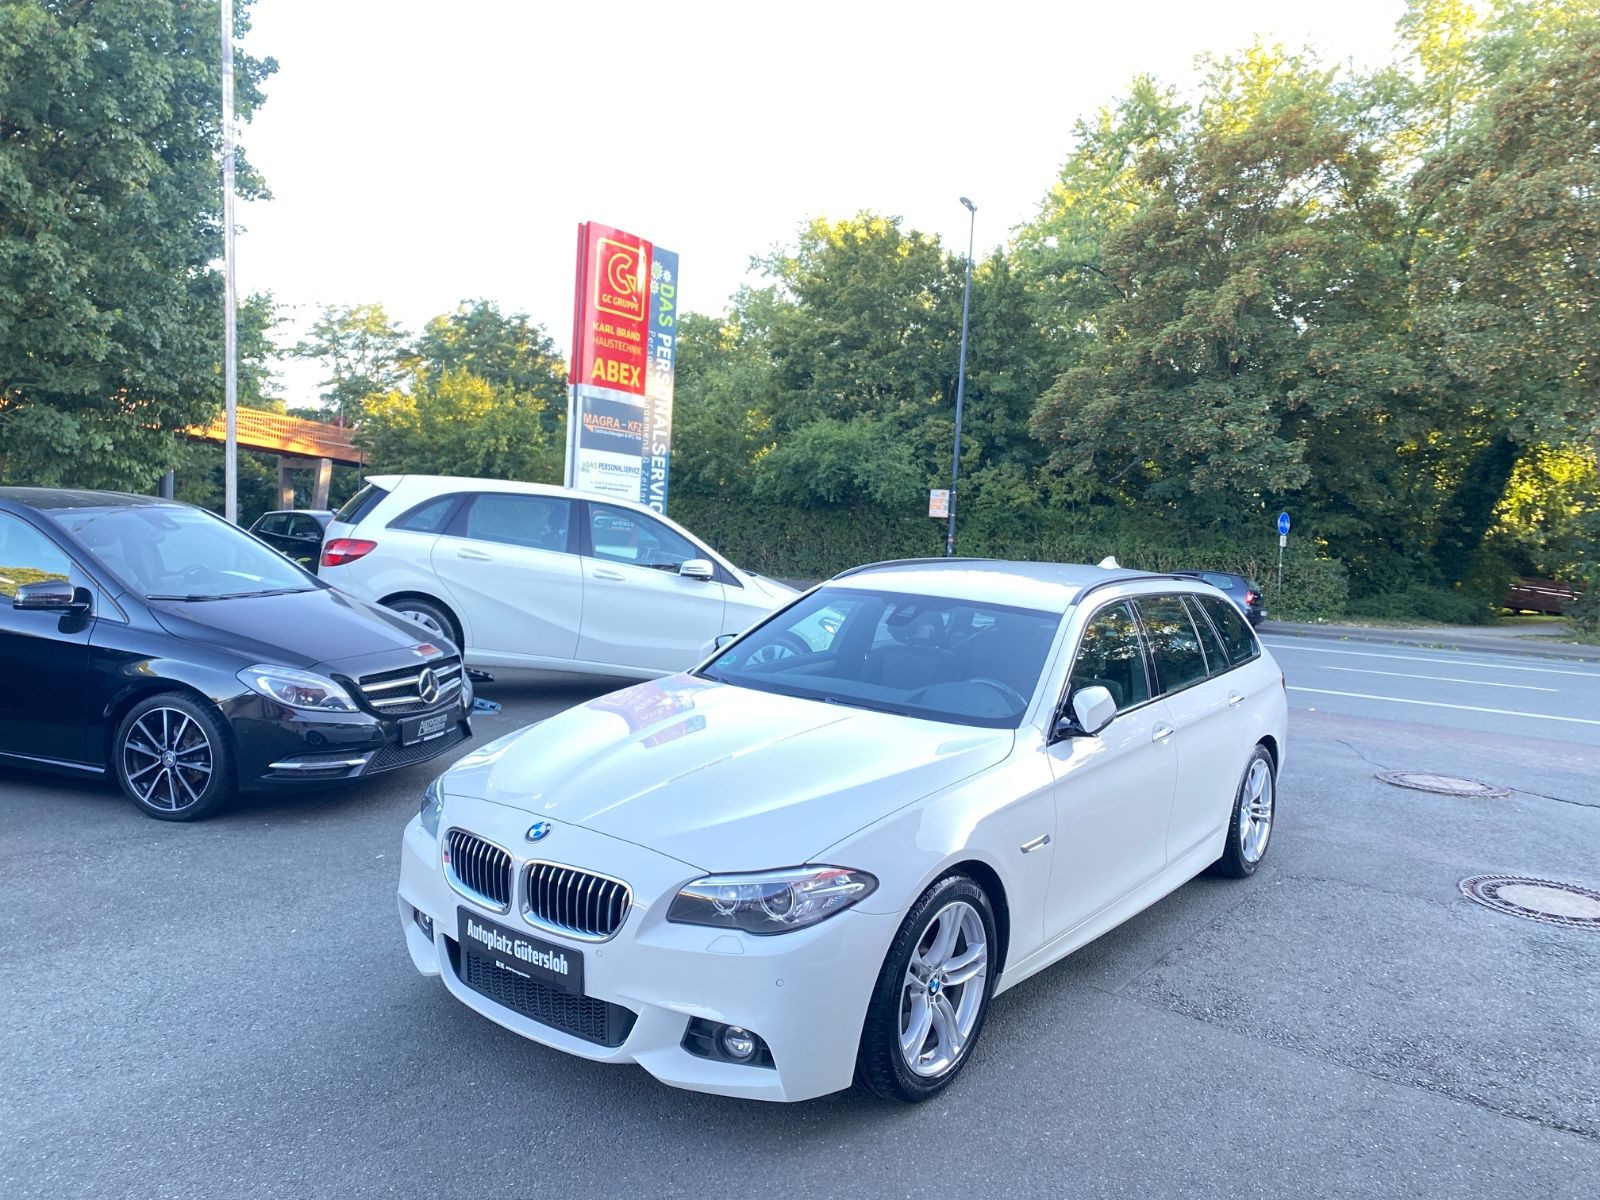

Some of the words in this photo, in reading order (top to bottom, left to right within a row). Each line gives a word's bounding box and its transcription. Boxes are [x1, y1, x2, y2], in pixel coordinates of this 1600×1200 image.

[602, 294, 612, 304] GC
[613, 297, 639, 312] GRUPPE
[659, 282, 675, 327] DAS
[592, 321, 615, 335] KARL
[616, 327, 641, 342] BRAND
[592, 336, 642, 355] HAUSTECHNIK
[591, 357, 641, 387] ABEX
[583, 413, 620, 429] MAGRA
[627, 420, 643, 433] KFZ
[649, 332, 672, 515] PERSONALSERVIC
[598, 463, 640, 475] PERSONALSERVICE
[467, 919, 513, 955] Autoplatz
[514, 939, 569, 975] Gütersloh
